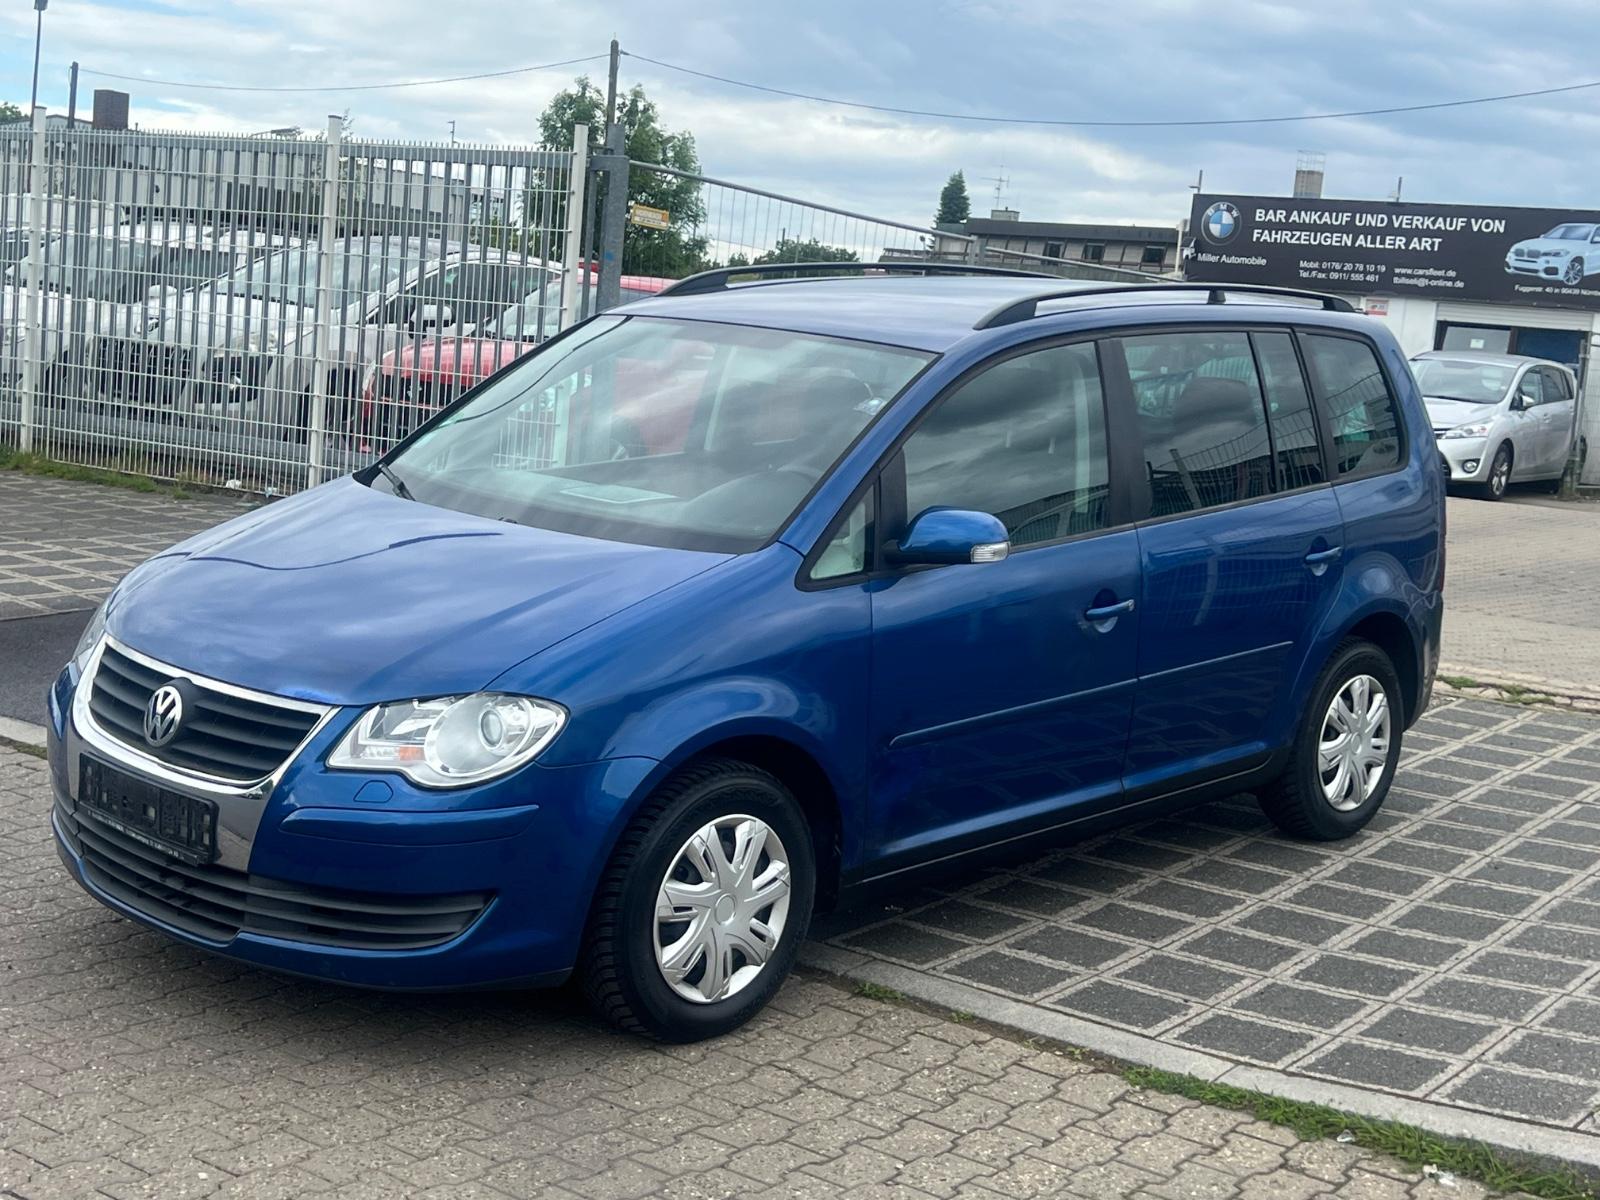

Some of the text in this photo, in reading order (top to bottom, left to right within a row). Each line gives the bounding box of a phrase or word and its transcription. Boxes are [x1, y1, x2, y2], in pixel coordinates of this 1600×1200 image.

[1255, 209, 1506, 234] BAR ANKAUF UND VERKAUF VON
[1252, 229, 1443, 252] FAHRZEUGEN ALLER ART
[1197, 252, 1267, 266] Miller Automobile
[1343, 263, 1353, 271] 20
[1365, 264, 1375, 272] 10
